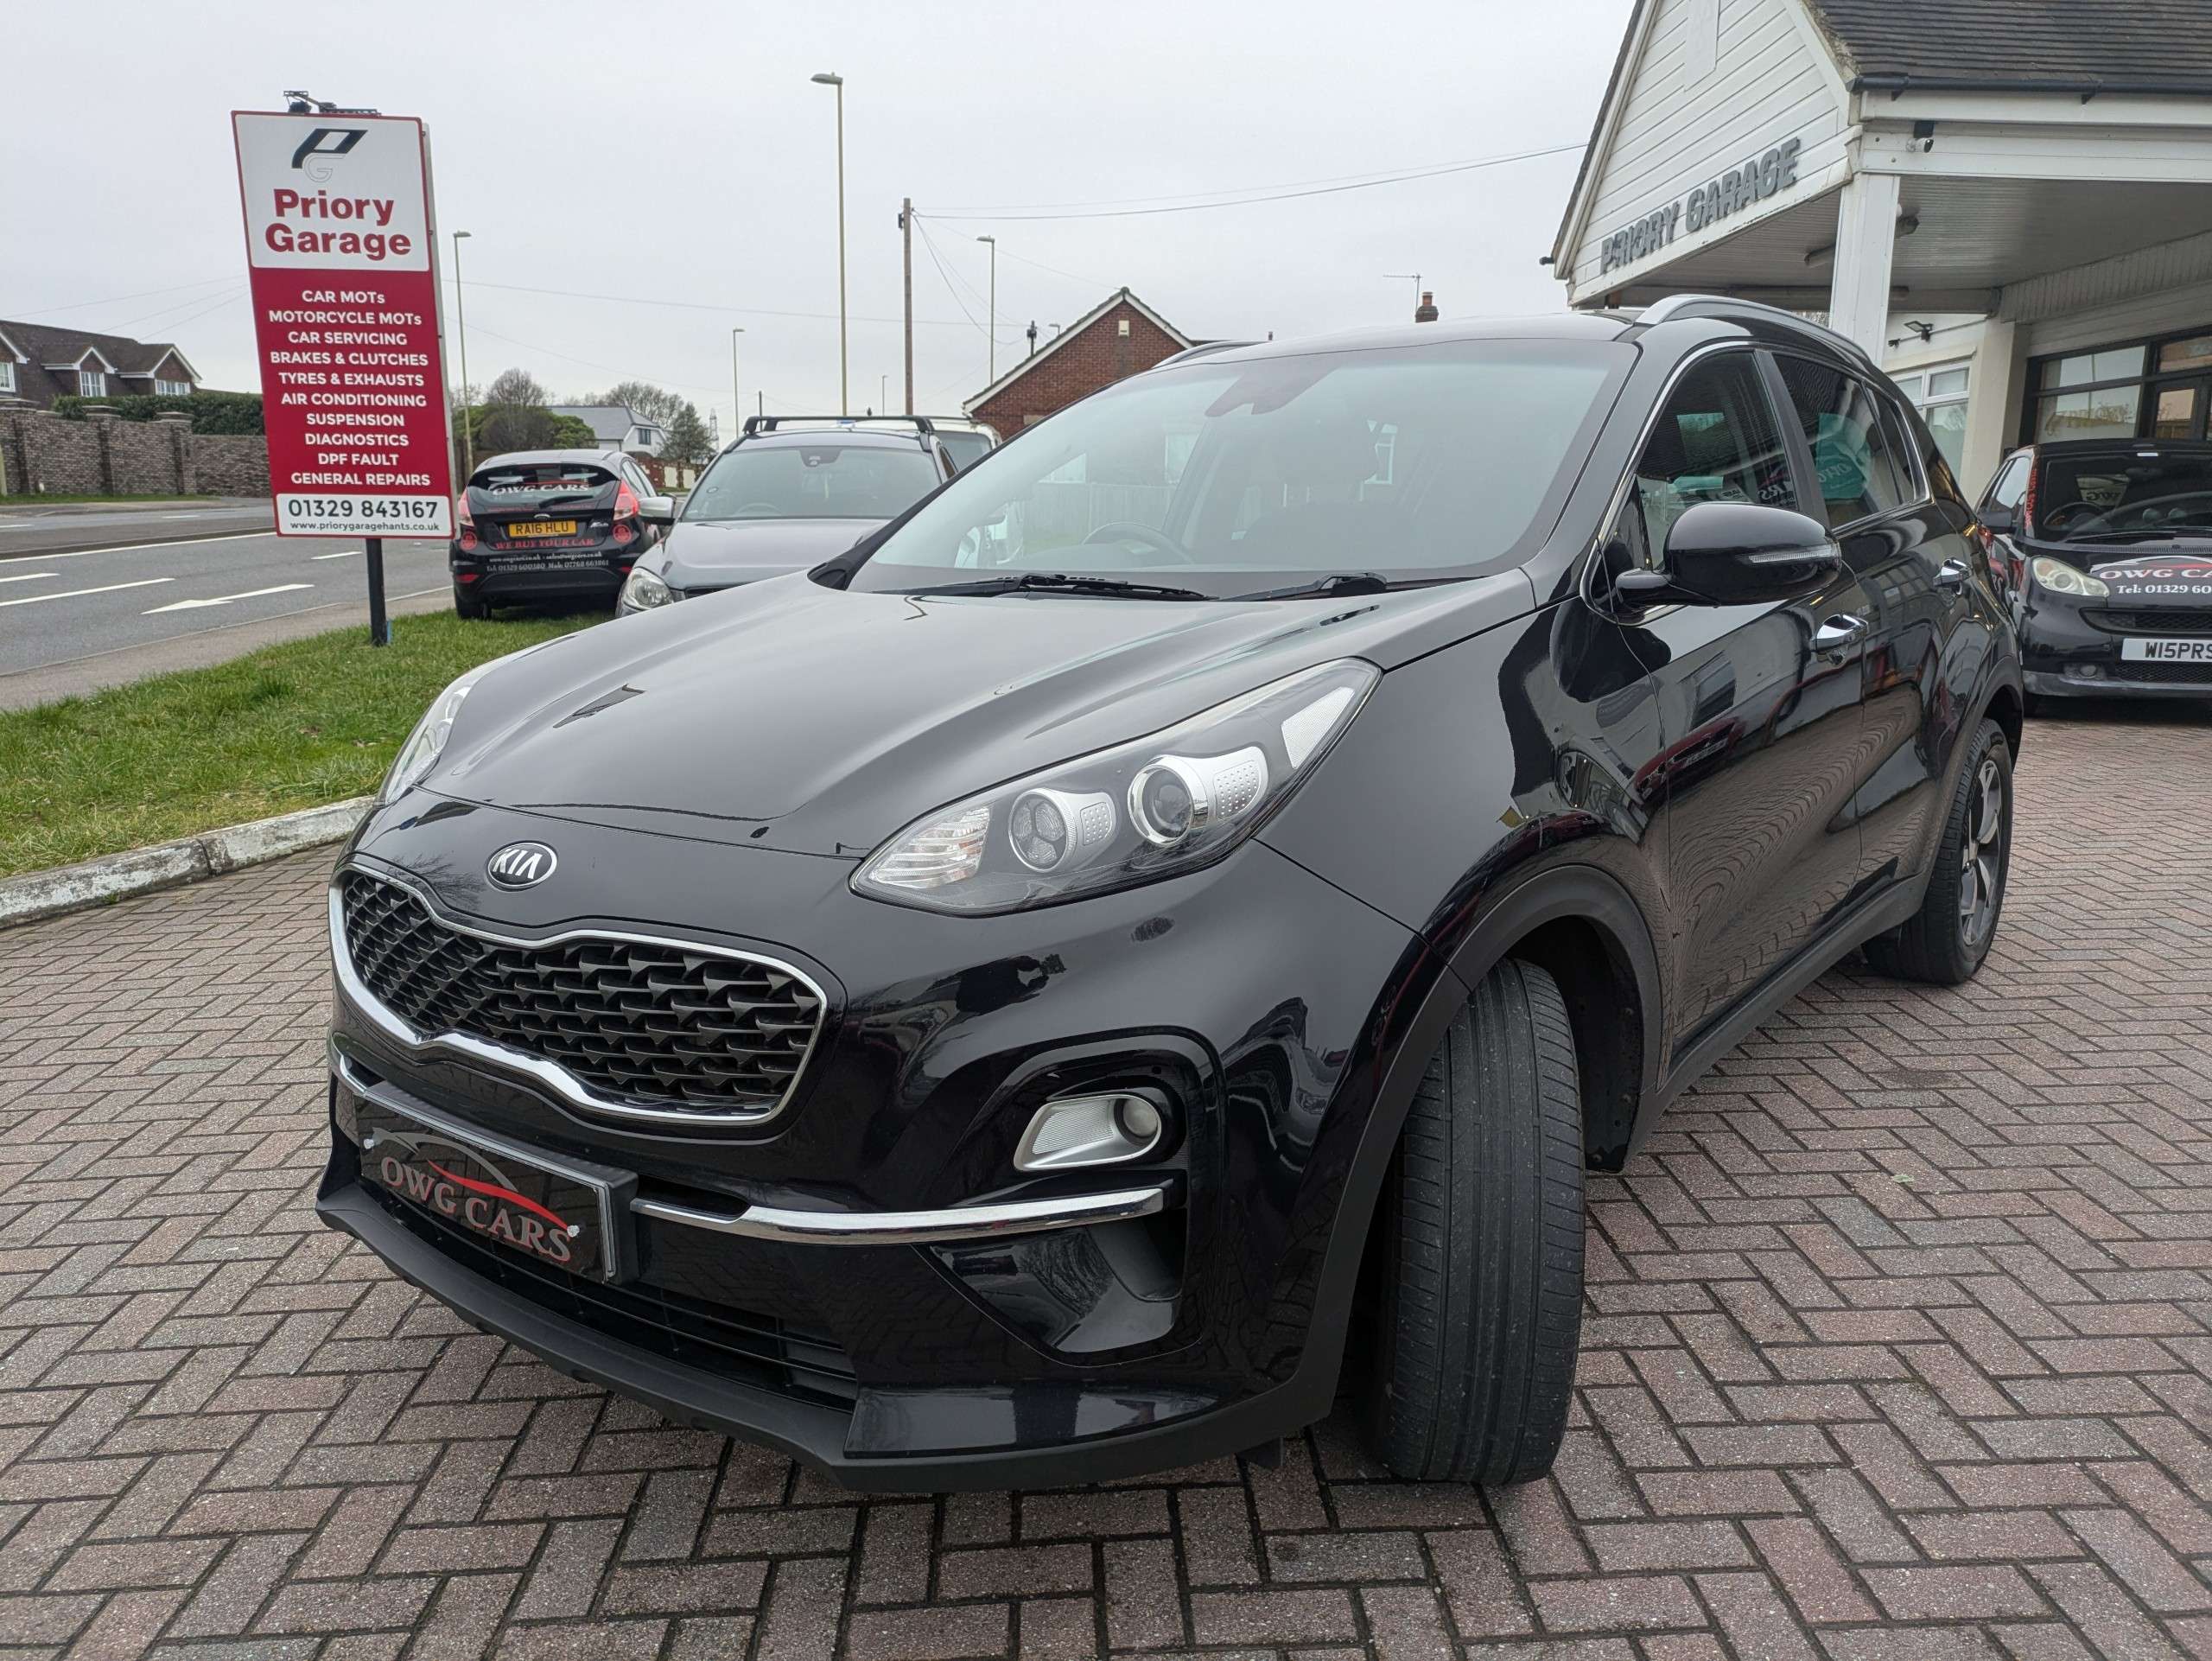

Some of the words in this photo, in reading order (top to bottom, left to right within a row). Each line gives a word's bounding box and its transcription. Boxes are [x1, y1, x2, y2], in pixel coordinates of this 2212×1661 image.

[273, 188, 394, 226] Priory
[1600, 200, 1681, 275] PRIORY
[1686, 136, 1800, 232] GARAGE
[265, 223, 411, 261] Garage
[302, 290, 335, 302] CAR
[340, 291, 385, 303] MOTs
[269, 310, 375, 324] MOTORCYCLE
[379, 313, 422, 325] MOTs
[288, 332, 321, 343] CAR
[324, 332, 407, 345] SERVICING
[270, 352, 331, 364] BRAKES
[334, 353, 345, 365] &
[348, 353, 429, 366] CLUTCHES
[278, 372, 326, 385] TYRES
[330, 373, 341, 385] &
[344, 373, 424, 386] EXHAUSTS
[281, 392, 308, 404] AIR
[311, 393, 427, 407] CONDITIONING
[306, 413, 404, 426] SUSPENSION
[305, 433, 409, 446] DIAGNOSTICS
[318, 454, 347, 465] DPF
[352, 454, 399, 466] FAULT
[290, 473, 362, 485] GENERAL
[365, 474, 430, 486] REPAIRS
[492, 485, 536, 495] OWG
[289, 500, 353, 517] 01329
[361, 500, 437, 518] 843167
[290, 521, 439, 531] www.priorygaragehants.co.uk
[516, 522, 543, 535] RA16
[545, 521, 569, 533] HLU
[495, 541, 512, 550] WE
[2100, 569, 2174, 579] OWG
[2117, 584, 2141, 594] Tel:
[2145, 584, 2189, 594] 01329
[492, 848, 543, 880] KIA
[381, 1156, 457, 1214] OWG
[465, 1197, 571, 1262] CARS
